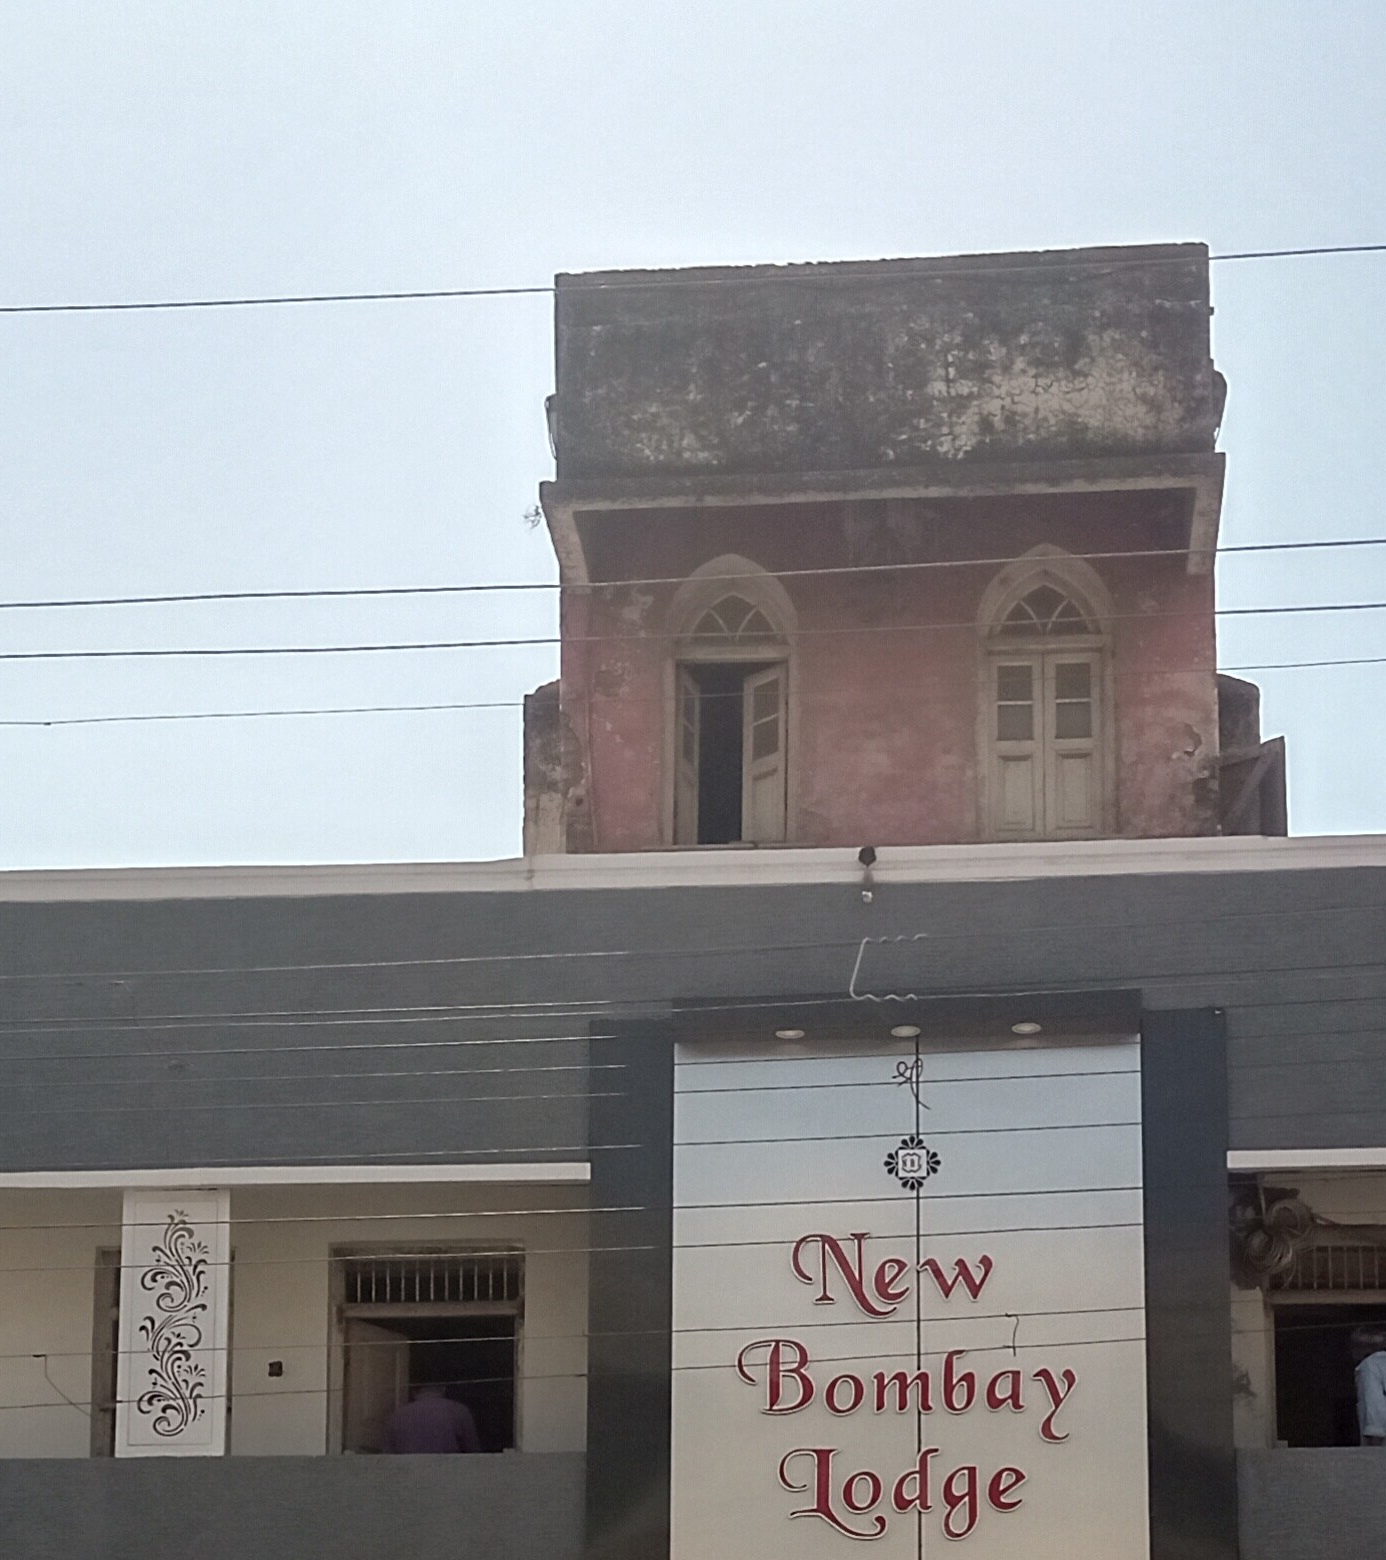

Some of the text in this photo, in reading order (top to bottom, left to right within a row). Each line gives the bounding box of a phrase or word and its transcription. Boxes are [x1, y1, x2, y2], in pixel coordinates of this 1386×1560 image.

[791, 1232, 994, 1318] New
[736, 1338, 1077, 1442] Bombay
[778, 1448, 1028, 1541] Lodge
